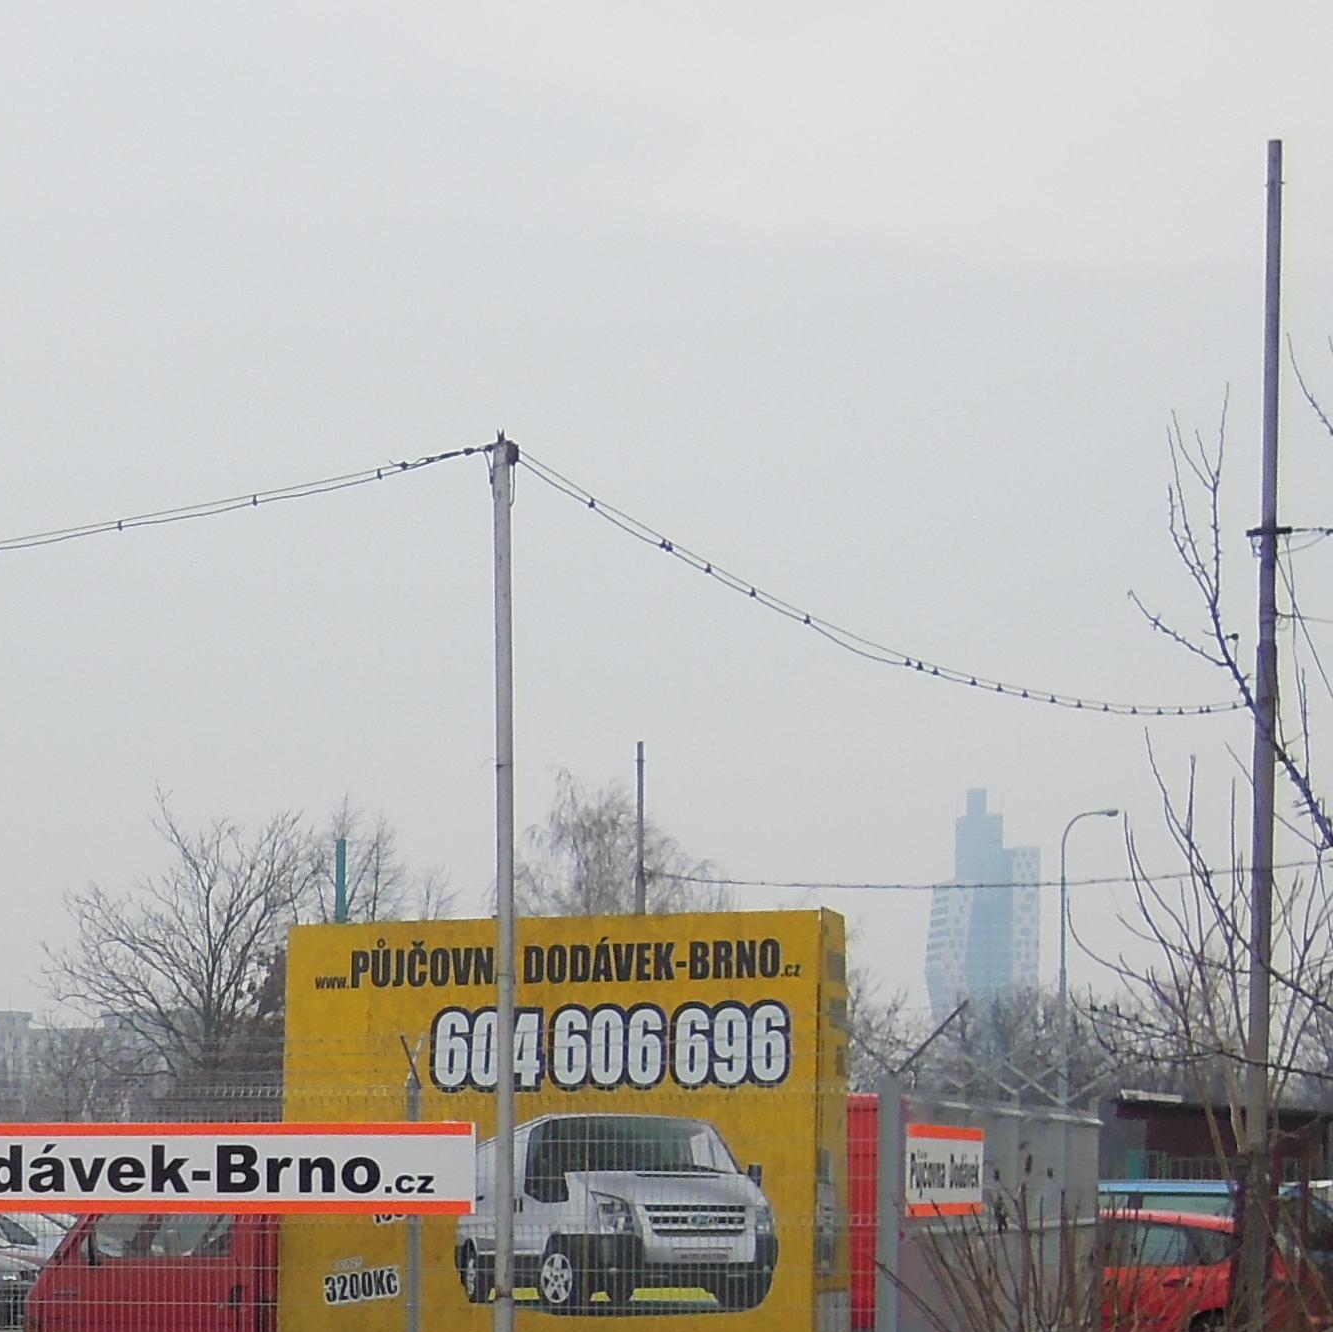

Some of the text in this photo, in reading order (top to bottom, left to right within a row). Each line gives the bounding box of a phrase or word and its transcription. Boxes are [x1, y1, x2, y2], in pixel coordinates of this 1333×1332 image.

[315, 937, 801, 990] www.PŮJČOVNDODÁVEK-BRNO.cz
[434, 1001, 790, 1090] 604 606 696
[324, 1268, 399, 1303] 3200Kč
